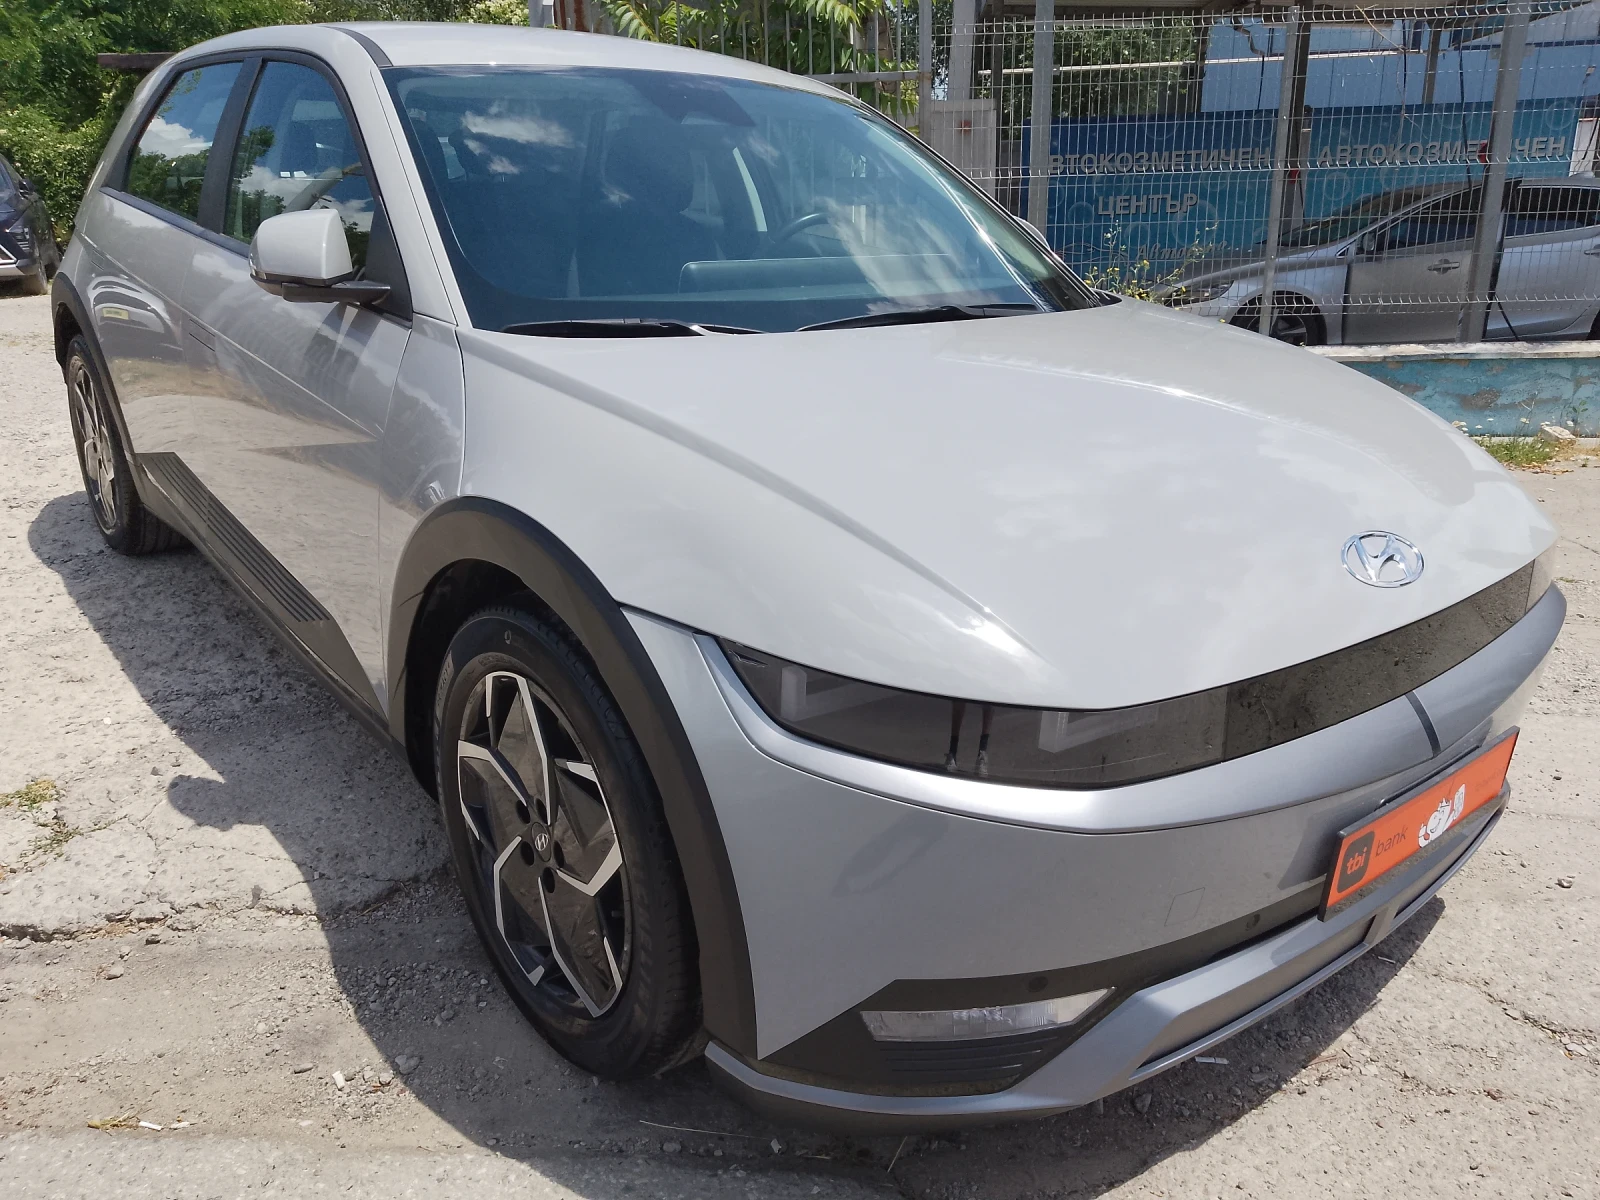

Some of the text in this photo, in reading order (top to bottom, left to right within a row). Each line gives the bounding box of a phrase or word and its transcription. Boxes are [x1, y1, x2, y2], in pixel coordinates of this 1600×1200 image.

[1048, 147, 1271, 174] ВТОКОЗМЕТИЧЕН
[1318, 136, 1565, 168] АВТОКОЗМЕЧЕН
[1097, 193, 1198, 219] ЦЕНТЪР
[1346, 824, 1409, 875] tbi bank
